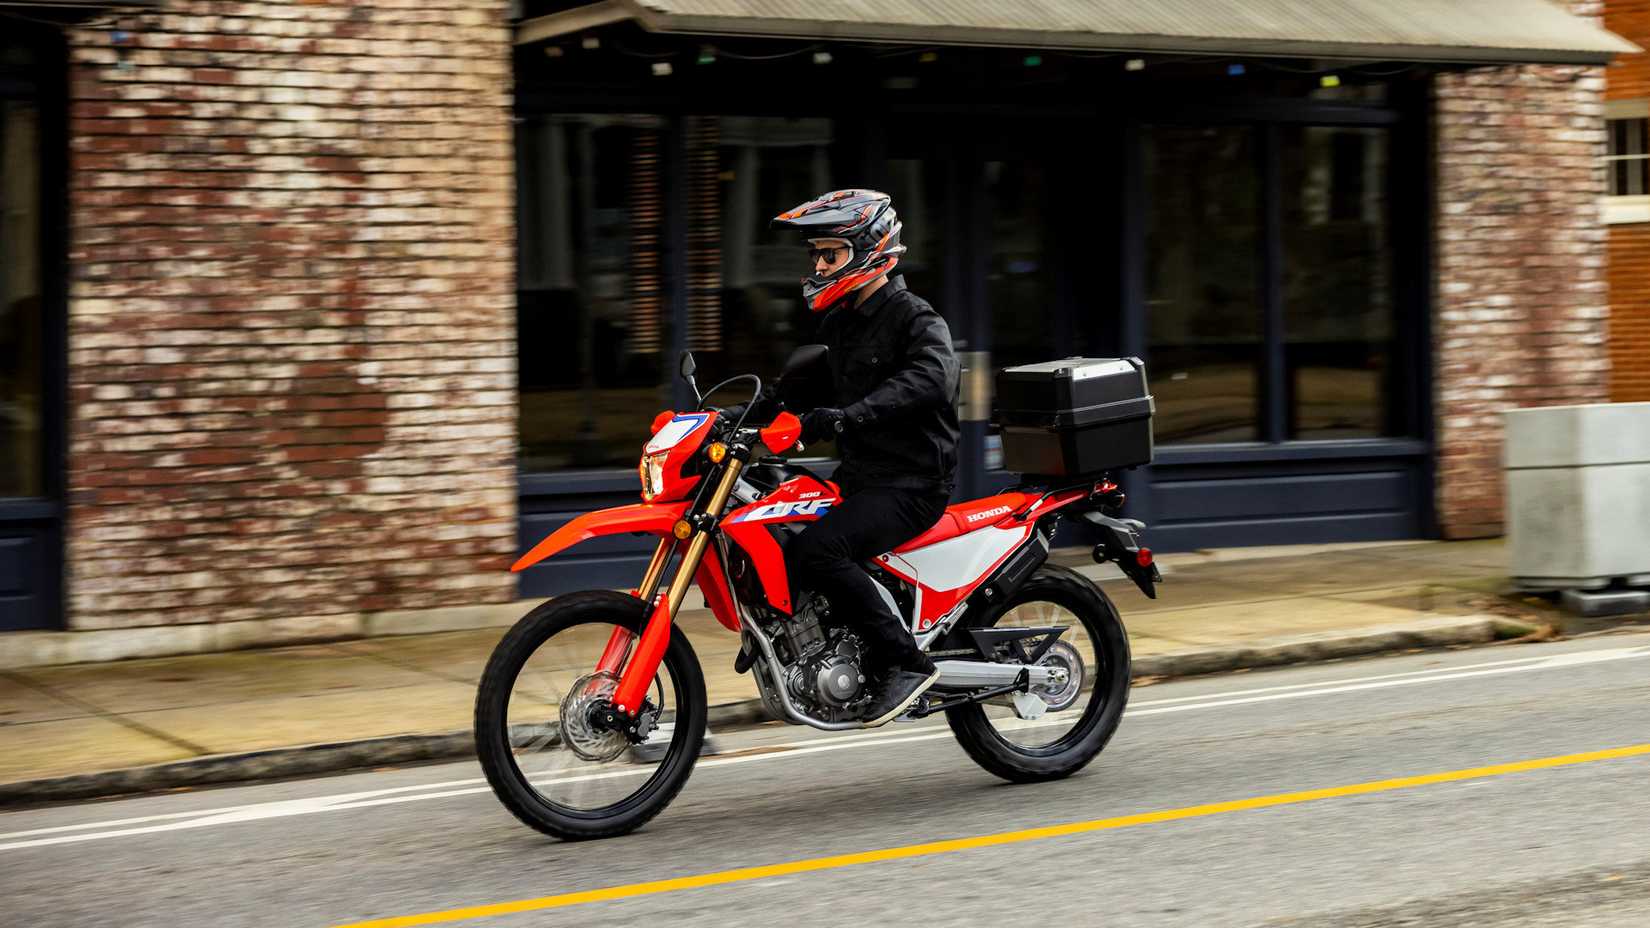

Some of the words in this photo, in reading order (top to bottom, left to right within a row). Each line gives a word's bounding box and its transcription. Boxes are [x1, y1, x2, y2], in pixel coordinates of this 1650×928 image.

[798, 491, 821, 499] 300
[743, 498, 837, 521] CRF
[967, 505, 1013, 522] HONDA
